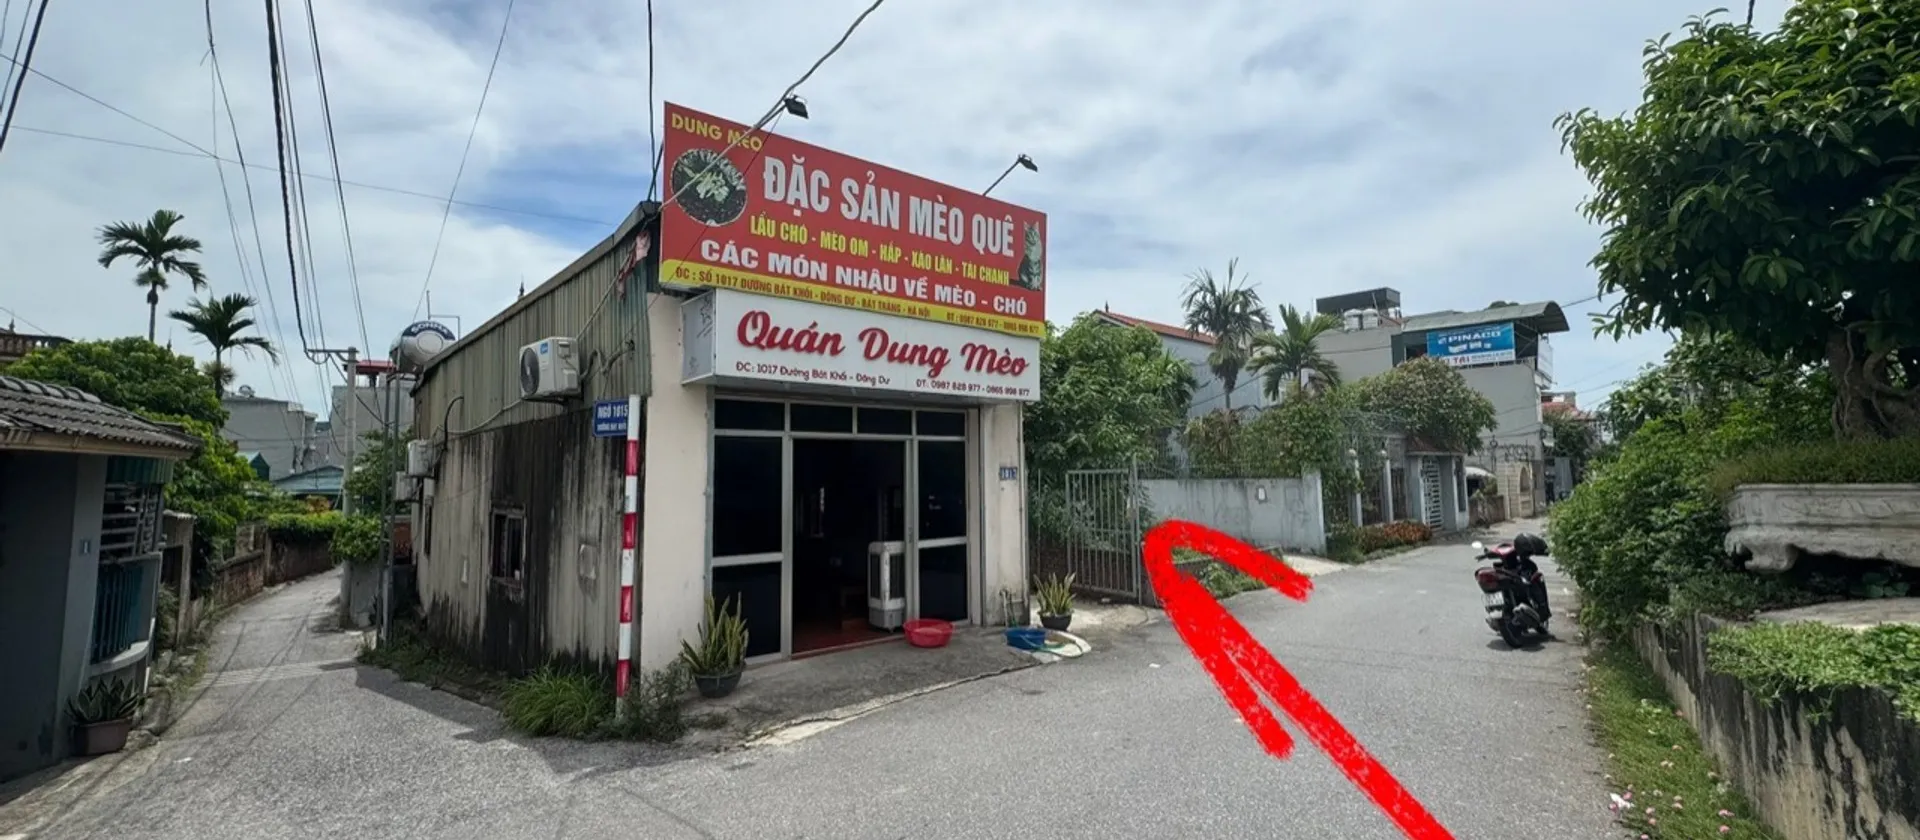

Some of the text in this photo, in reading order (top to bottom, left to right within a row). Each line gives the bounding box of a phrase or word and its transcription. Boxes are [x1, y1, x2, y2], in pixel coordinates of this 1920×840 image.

[672, 112, 722, 140] DUNG
[764, 154, 1014, 257] ĐẶC SẢN MÈO QUÊ
[701, 239, 759, 269] CÁC
[768, 251, 828, 282] MÓN
[835, 265, 897, 295] NHẬU
[934, 283, 976, 308] MÈO
[993, 294, 1027, 316] CHÓ
[715, 273, 738, 287] 1017
[850, 237, 868, 258] OM
[979, 265, 1010, 286] CHANH
[737, 309, 1030, 379] Quán Dung Mèo
[1448, 331, 1501, 343] PINACO
[757, 363, 778, 374] 1017
